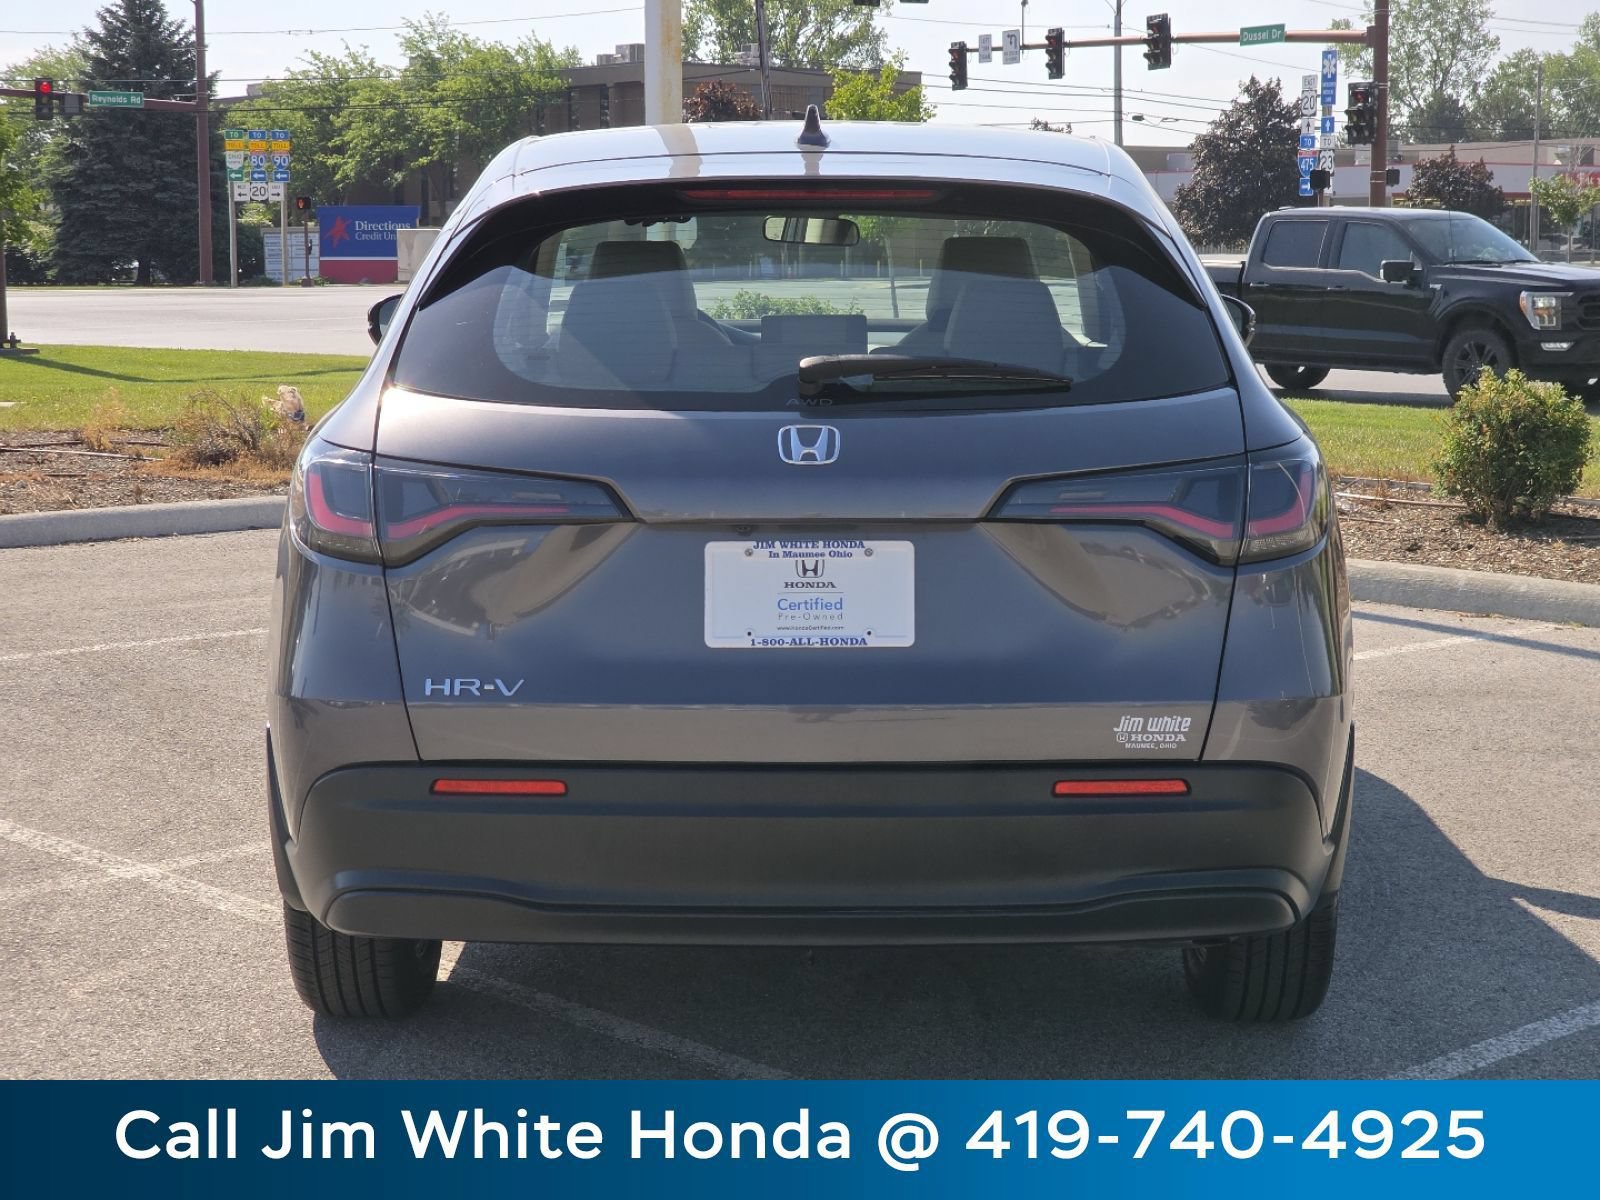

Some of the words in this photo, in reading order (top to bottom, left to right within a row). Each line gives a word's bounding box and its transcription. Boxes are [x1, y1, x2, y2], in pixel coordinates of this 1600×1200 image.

[1242, 30, 1269, 41] Dussel
[1271, 29, 1282, 39] Dr
[91, 94, 128, 104] Reynolds
[130, 96, 141, 104] Rd
[1302, 95, 1315, 110] 20
[1323, 138, 1332, 146] TO
[250, 155, 265, 166] 80
[273, 156, 289, 167] 90
[1300, 158, 1314, 171] 475
[1320, 155, 1333, 170] 23
[251, 186, 267, 197] 20
[355, 220, 411, 231] Directions
[355, 232, 383, 241] Credit
[786, 398, 833, 406] AWD
[753, 540, 776, 549] JIM
[779, 540, 819, 549] WHITE
[822, 540, 865, 549] HONDA
[828, 550, 853, 558] Ohio
[783, 581, 837, 589] HONDA
[777, 597, 843, 611] Certified
[778, 612, 843, 621] Pre-Owned
[750, 637, 868, 646] 1-800-ALL-HONDA
[424, 678, 525, 697] HR-V
[1112, 715, 1144, 732] Jim
[1130, 733, 1187, 742] HONDA
